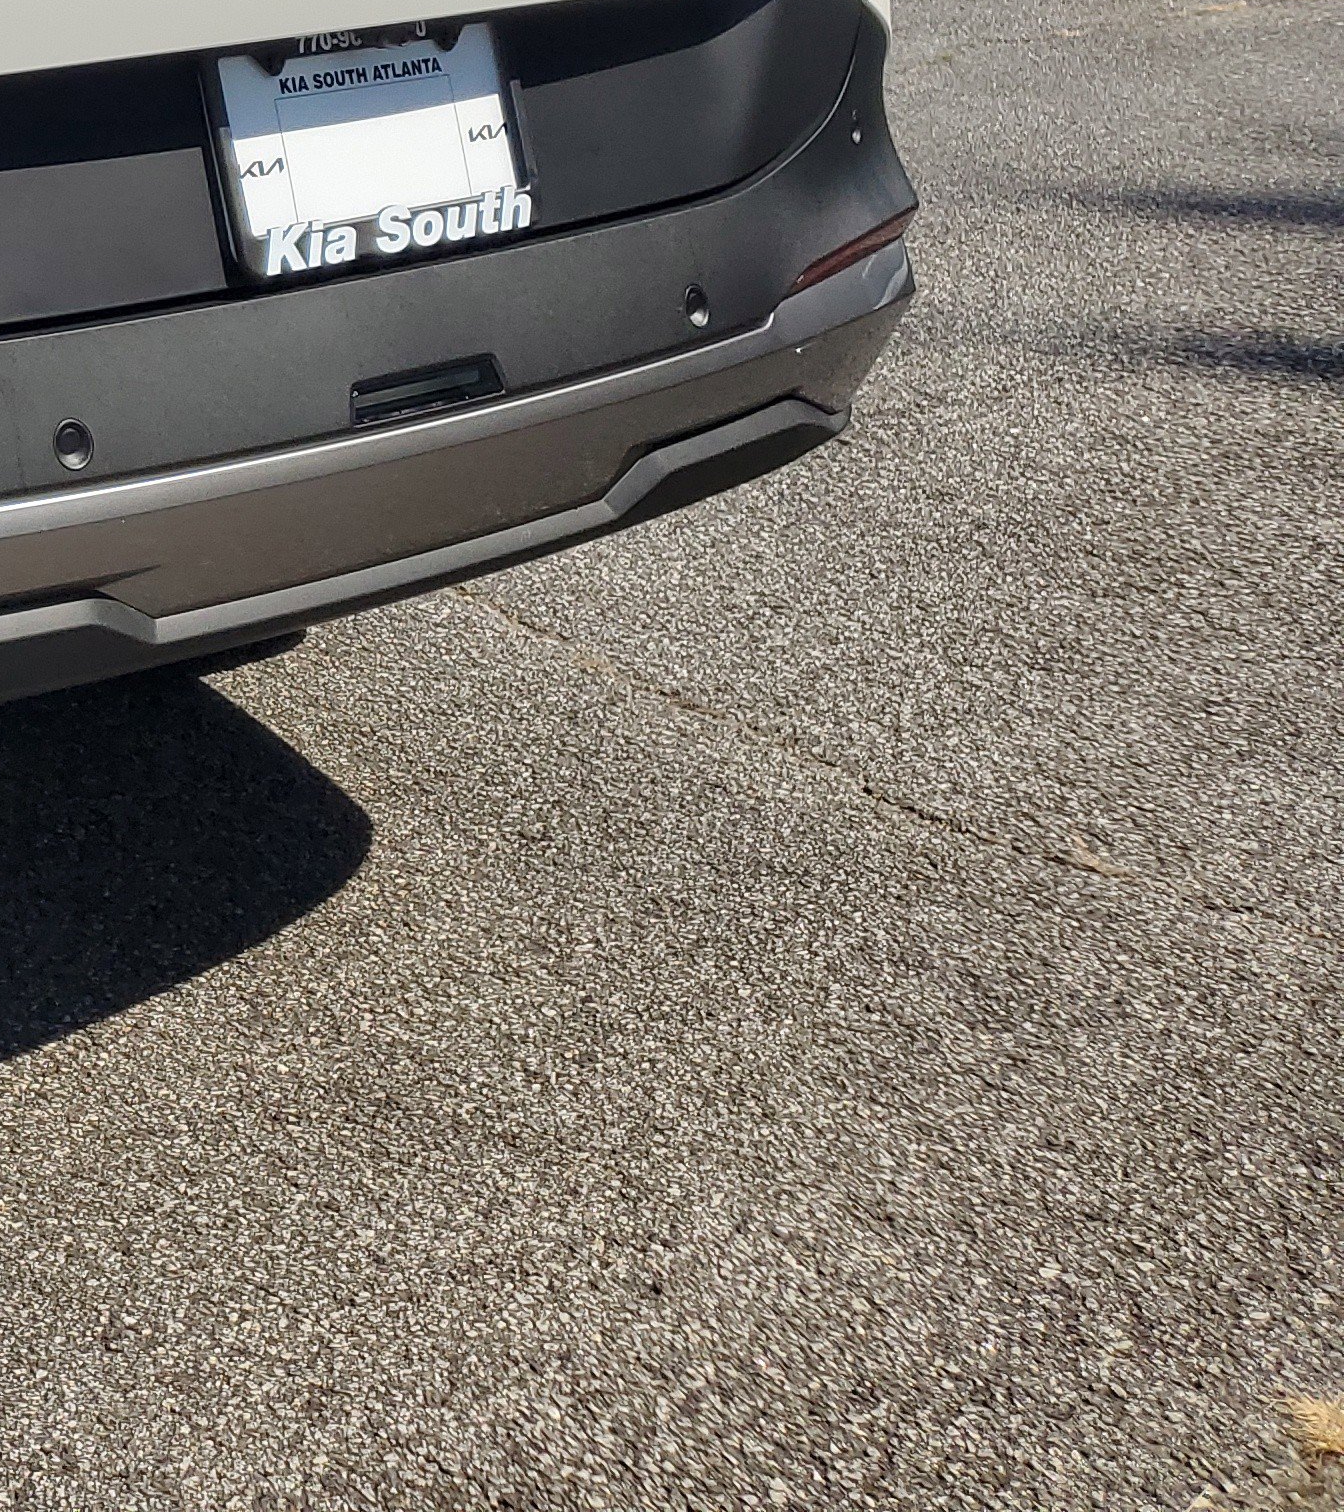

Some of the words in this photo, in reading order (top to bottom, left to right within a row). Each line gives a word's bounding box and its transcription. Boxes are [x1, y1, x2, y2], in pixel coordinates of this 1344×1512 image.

[278, 75, 310, 95] KIA
[312, 67, 369, 90] SOUTH
[372, 56, 443, 82] ATLANTA
[468, 122, 508, 143] KIA
[266, 218, 357, 276] Kia
[376, 185, 532, 255] South
